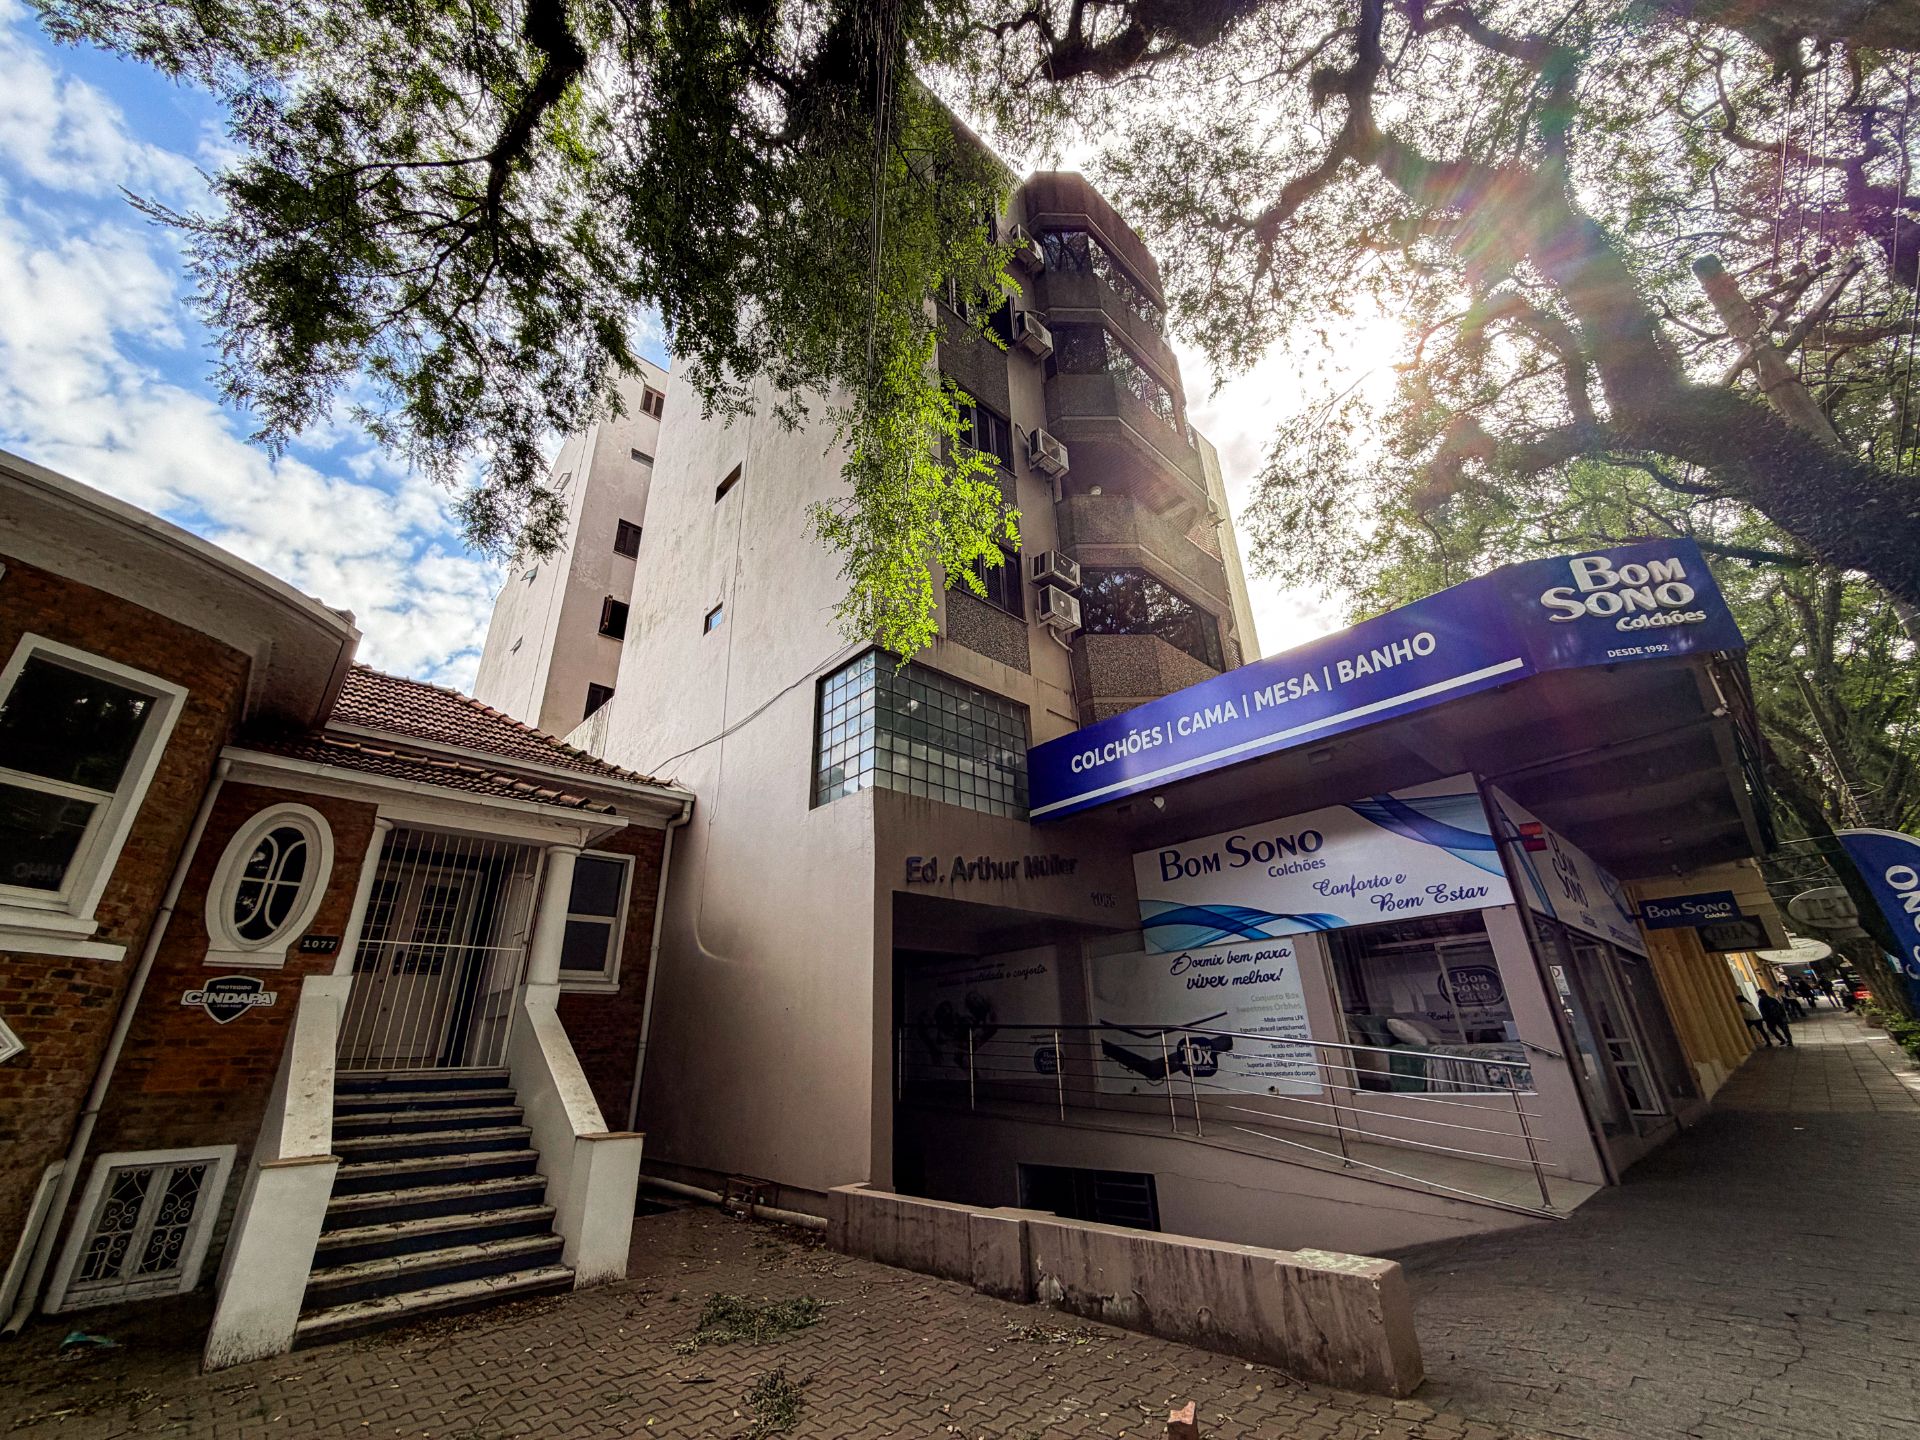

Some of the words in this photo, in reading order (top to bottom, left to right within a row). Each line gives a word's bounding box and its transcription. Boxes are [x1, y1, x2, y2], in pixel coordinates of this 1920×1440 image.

[1569, 555, 1687, 594] BOM
[1540, 580, 1696, 624] SONO
[1615, 608, 1707, 632] Colchões
[1607, 646, 1643, 658] DESDE
[1644, 643, 1670, 655] 1992
[1070, 724, 1164, 774] COLCHÕES
[1177, 700, 1240, 737] CAMA
[1254, 673, 1319, 712] MESA
[1337, 631, 1437, 684] BANHO
[1158, 848, 1222, 882] BOM
[1224, 829, 1325, 868] SONO
[1267, 857, 1327, 879] Colchões
[905, 856, 945, 883] Ed.
[950, 855, 1020, 883] Arthur
[1312, 875, 1392, 898] Conforto
[1394, 872, 1407, 885] e
[1371, 892, 1424, 913] Bem
[1425, 882, 1489, 905] Estar
[1645, 904, 1682, 919] BOM
[1681, 901, 1731, 916] SONO
[303, 938, 337, 950] 1077
[1171, 950, 1225, 976] Dormir
[1225, 948, 1253, 965] bem
[1255, 947, 1292, 965] para
[1186, 969, 1228, 990] viver
[1231, 966, 1284, 988] melhor!
[1456, 971, 1488, 984] BOM
[186, 991, 272, 1006] CINDAPA
